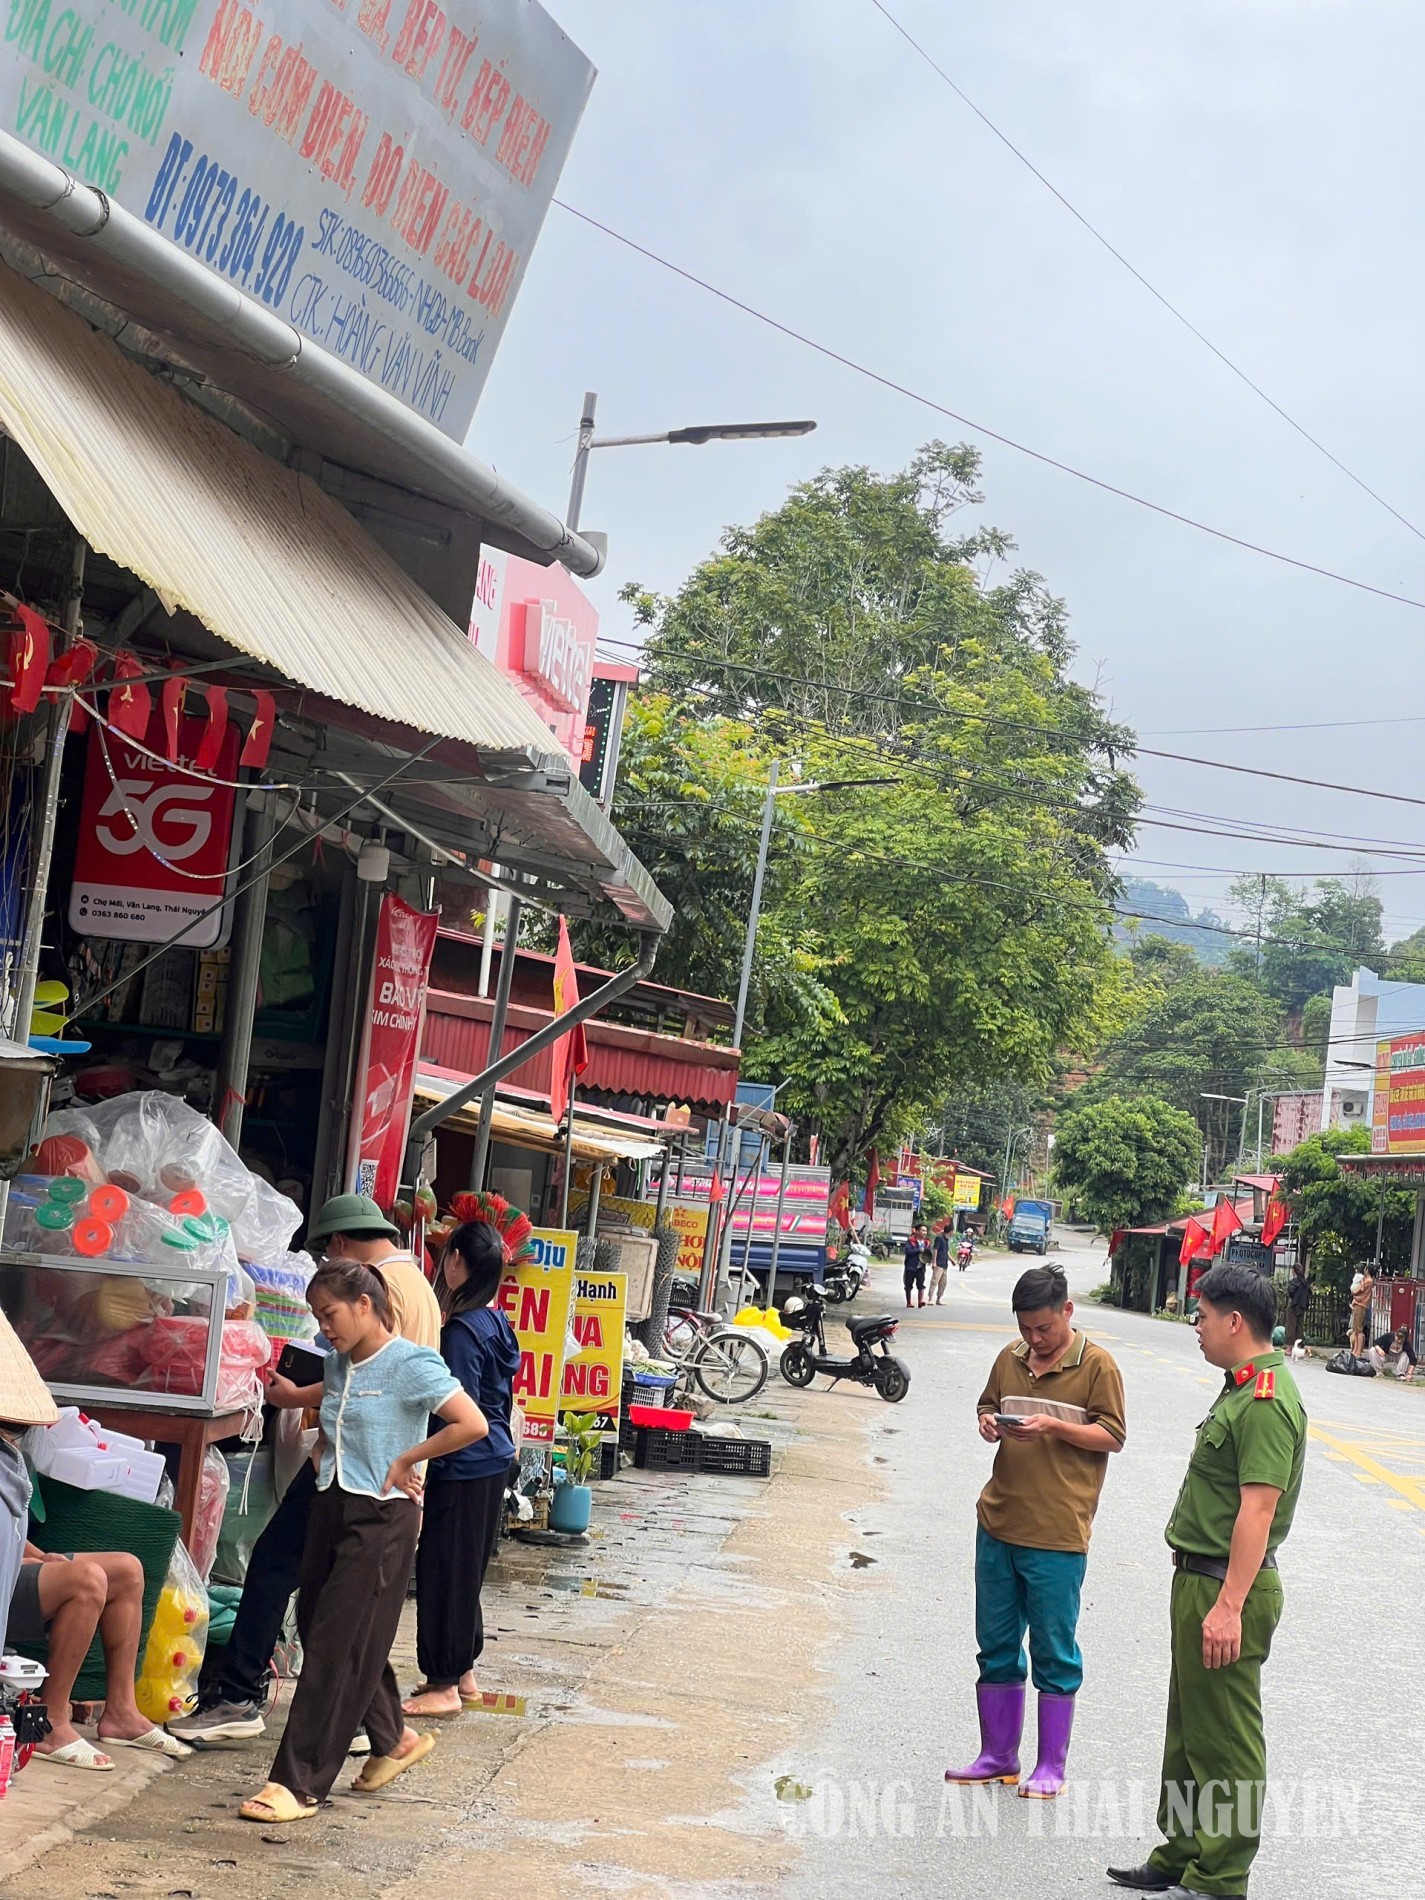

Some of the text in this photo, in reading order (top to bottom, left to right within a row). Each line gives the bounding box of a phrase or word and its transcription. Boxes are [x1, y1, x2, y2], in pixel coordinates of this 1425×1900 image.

[249, 35, 319, 147] CƠM
[16, 76, 129, 198] VĂN LANG
[324, 293, 388, 374] HOÀNG
[381, 331, 419, 397] VĂN
[412, 349, 456, 423] VĨNH
[96, 778, 215, 861] 5G
[92, 909, 145, 921] 0363 860 680
[93, 898, 107, 907] Chợ
[142, 903, 162, 912] Lang,
[182, 907, 206, 917] Nguyê
[671, 1218, 699, 1229] BECO
[577, 1279, 617, 1302] Hạnh
[561, 1363, 610, 1397] NG
